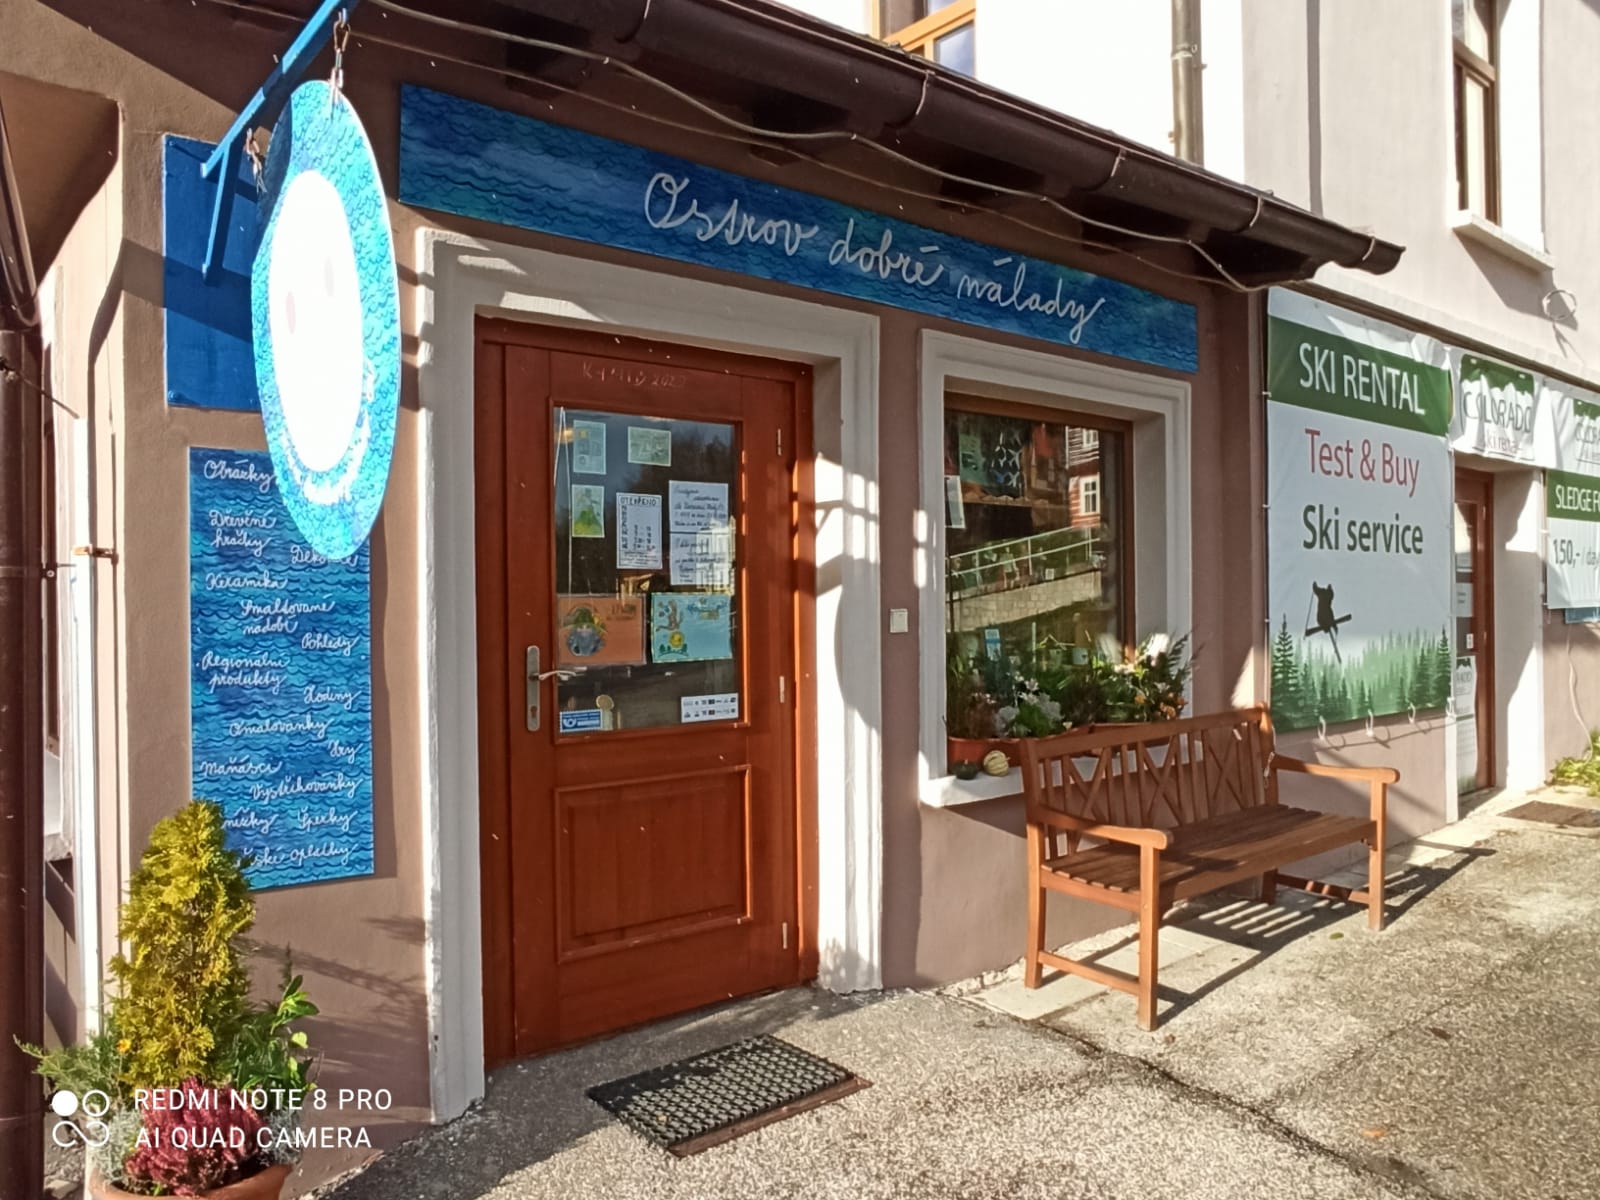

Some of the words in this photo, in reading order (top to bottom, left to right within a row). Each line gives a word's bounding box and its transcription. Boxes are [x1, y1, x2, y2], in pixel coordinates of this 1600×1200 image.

[645, 172, 818, 255] Ostrov
[829, 218, 944, 286] dobré
[957, 257, 1106, 344] nálady
[1299, 343, 1336, 394] SKI
[1343, 355, 1426, 416] RENTAL
[1305, 428, 1354, 479] Test
[1360, 439, 1376, 482] &
[1382, 443, 1420, 498] Buy
[203, 459, 276, 493] Obrázky
[1555, 484, 1592, 512] SLEDGE
[208, 507, 277, 529] Dřevěné
[1302, 504, 1340, 551] Ski
[1346, 513, 1424, 555] service
[211, 529, 274, 557] hračky
[205, 570, 288, 591] Keramika
[243, 615, 298, 636] nádobí
[301, 632, 360, 656] Pohledy
[201, 651, 291, 671] Regionální
[208, 670, 287, 694] produkty
[303, 684, 362, 710] Hodiny
[228, 713, 335, 738] Omalovánky
[326, 739, 364, 764] Hry
[199, 755, 283, 778] Maňásci
[297, 805, 358, 833] Šperky
[290, 842, 359, 866] oplatky
